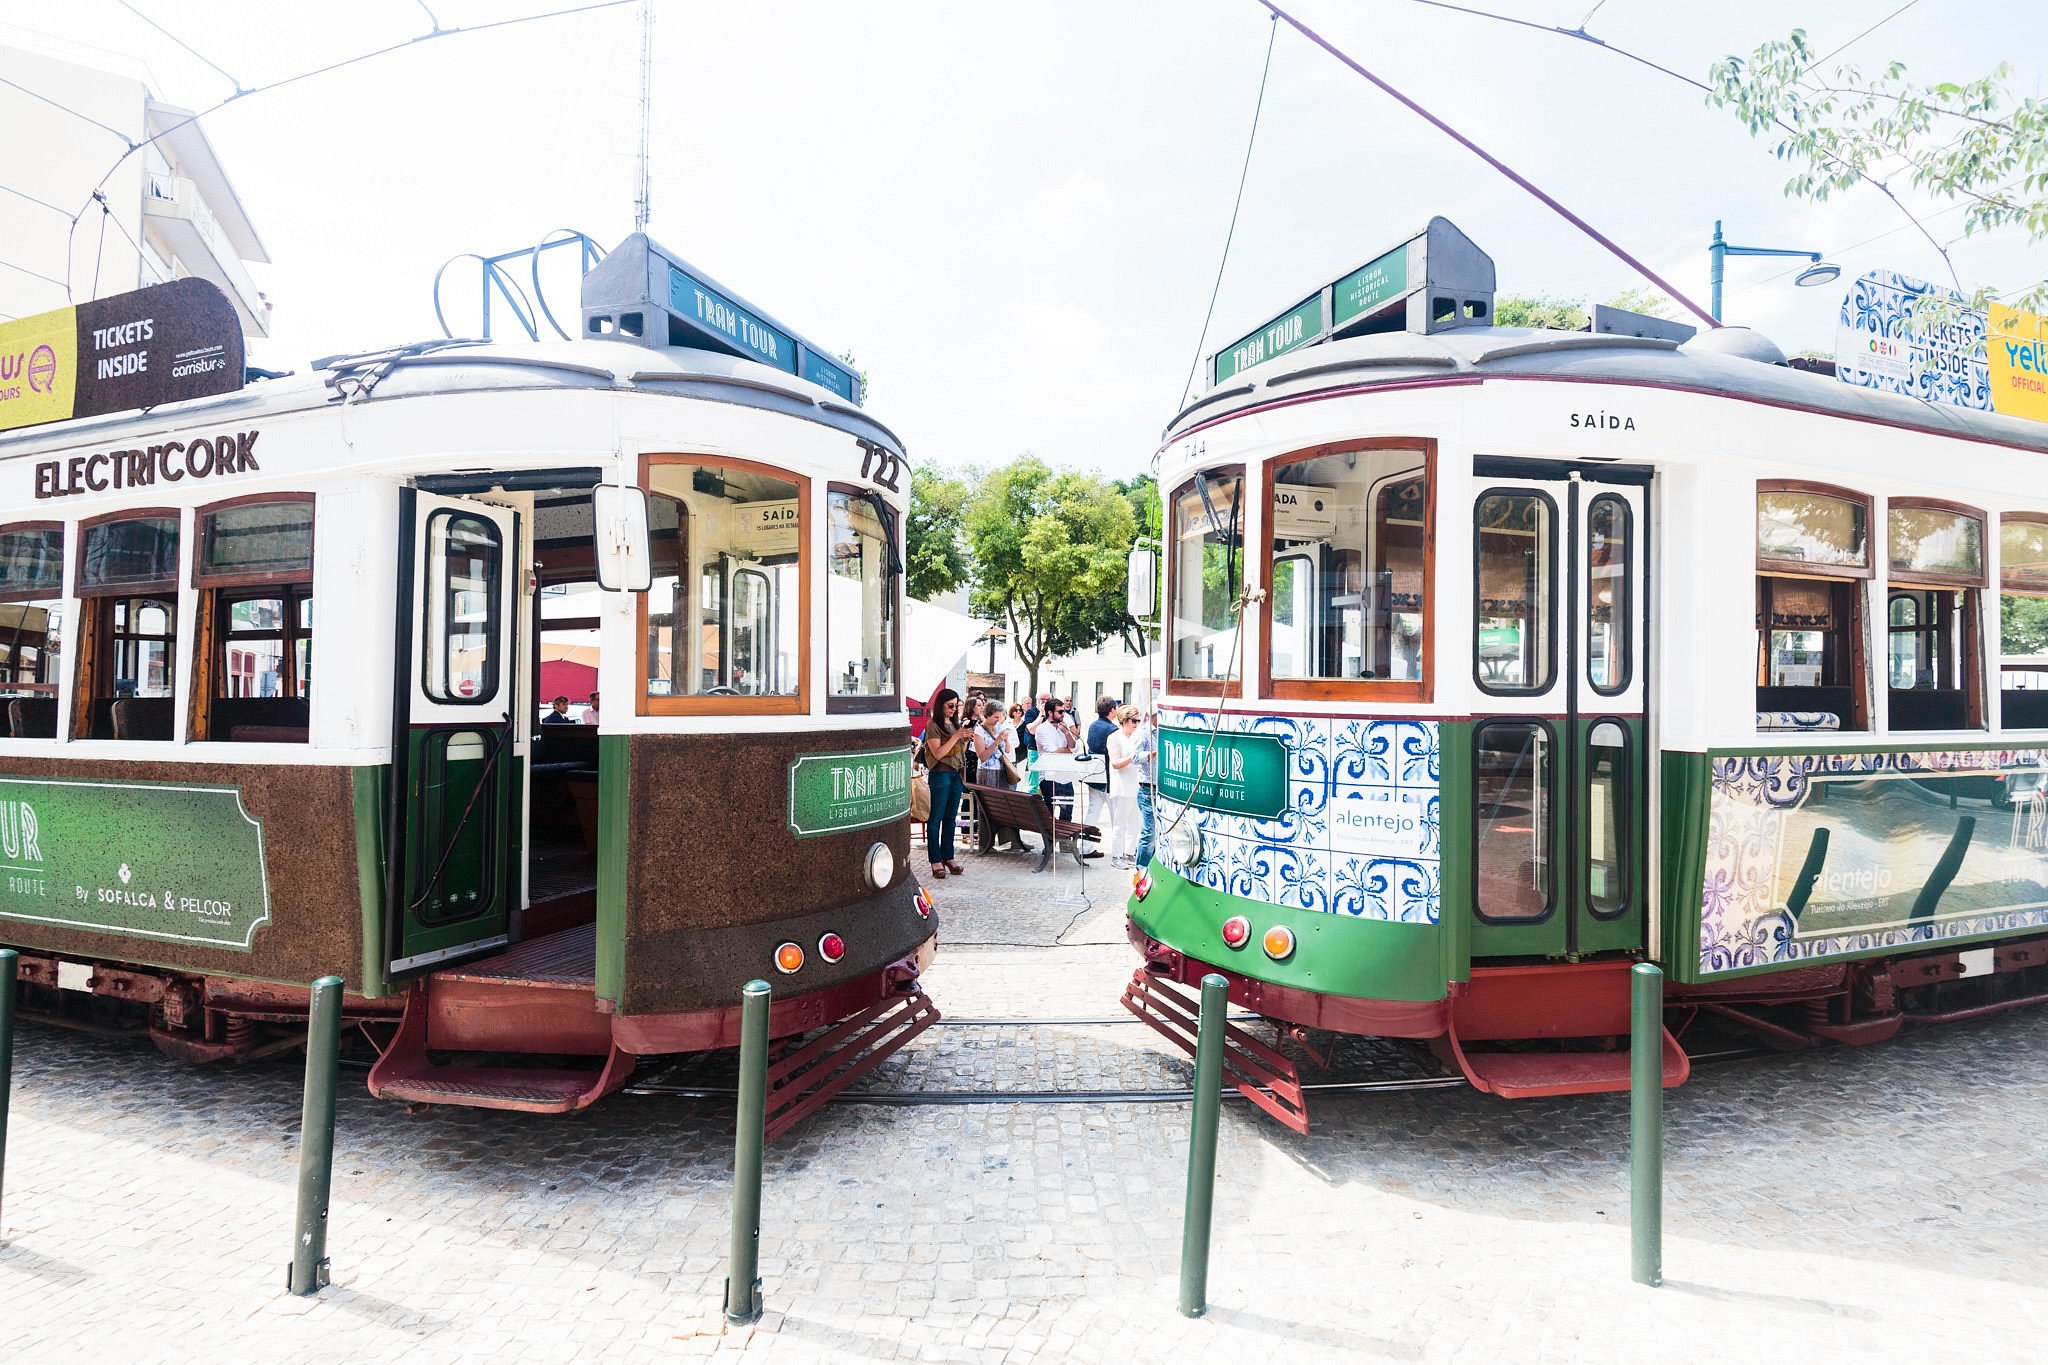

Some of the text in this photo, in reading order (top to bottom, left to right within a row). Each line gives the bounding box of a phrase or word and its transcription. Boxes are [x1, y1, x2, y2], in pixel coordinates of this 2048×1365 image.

[1350, 275, 1390, 302] HISTORICAL
[1357, 267, 1382, 287] LISBON
[1359, 290, 1380, 307] ROUTE
[93, 319, 154, 350] TICKETS
[694, 289, 778, 361] TRAM TOUR
[1233, 315, 1303, 374] TRAM TOUR
[97, 350, 147, 380] INSIDE
[172, 358, 217, 378] carristur
[1925, 348, 1969, 376] INSIDE
[2011, 376, 2047, 394] OFFICIAL
[1570, 409, 1635, 431] SAÍDA
[856, 438, 900, 494] 722
[1164, 739, 1245, 782] TRAM TOUR
[830, 765, 876, 800] TRAM
[1219, 788, 1245, 801] ROUTE
[829, 807, 857, 819] LISBON
[1336, 809, 1414, 834] alentejo
[9, 876, 46, 896] ROUTE
[75, 885, 231, 917] By SOFALCA & PELCOR
